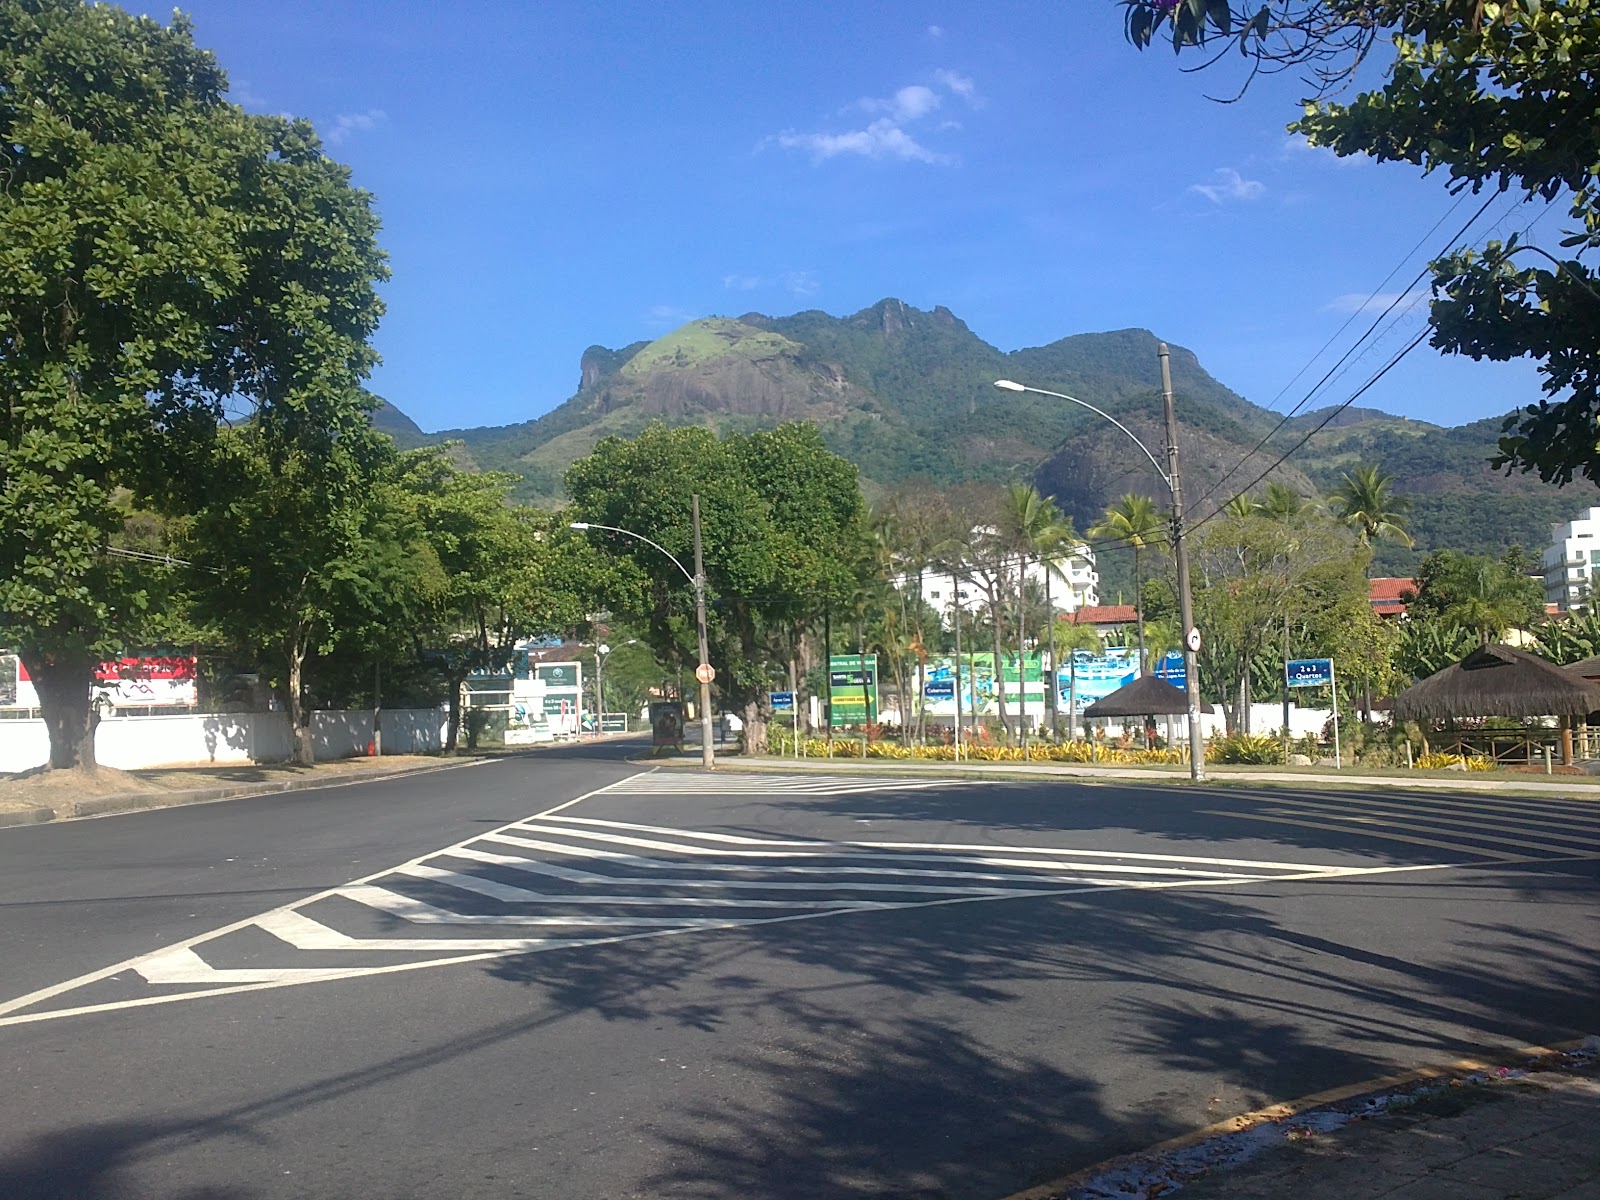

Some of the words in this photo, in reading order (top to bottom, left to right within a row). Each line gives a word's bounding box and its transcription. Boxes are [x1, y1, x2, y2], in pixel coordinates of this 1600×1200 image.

[1300, 665, 1306, 673] 2
[1312, 664, 1317, 672] 3
[1295, 672, 1323, 680] Quartos
